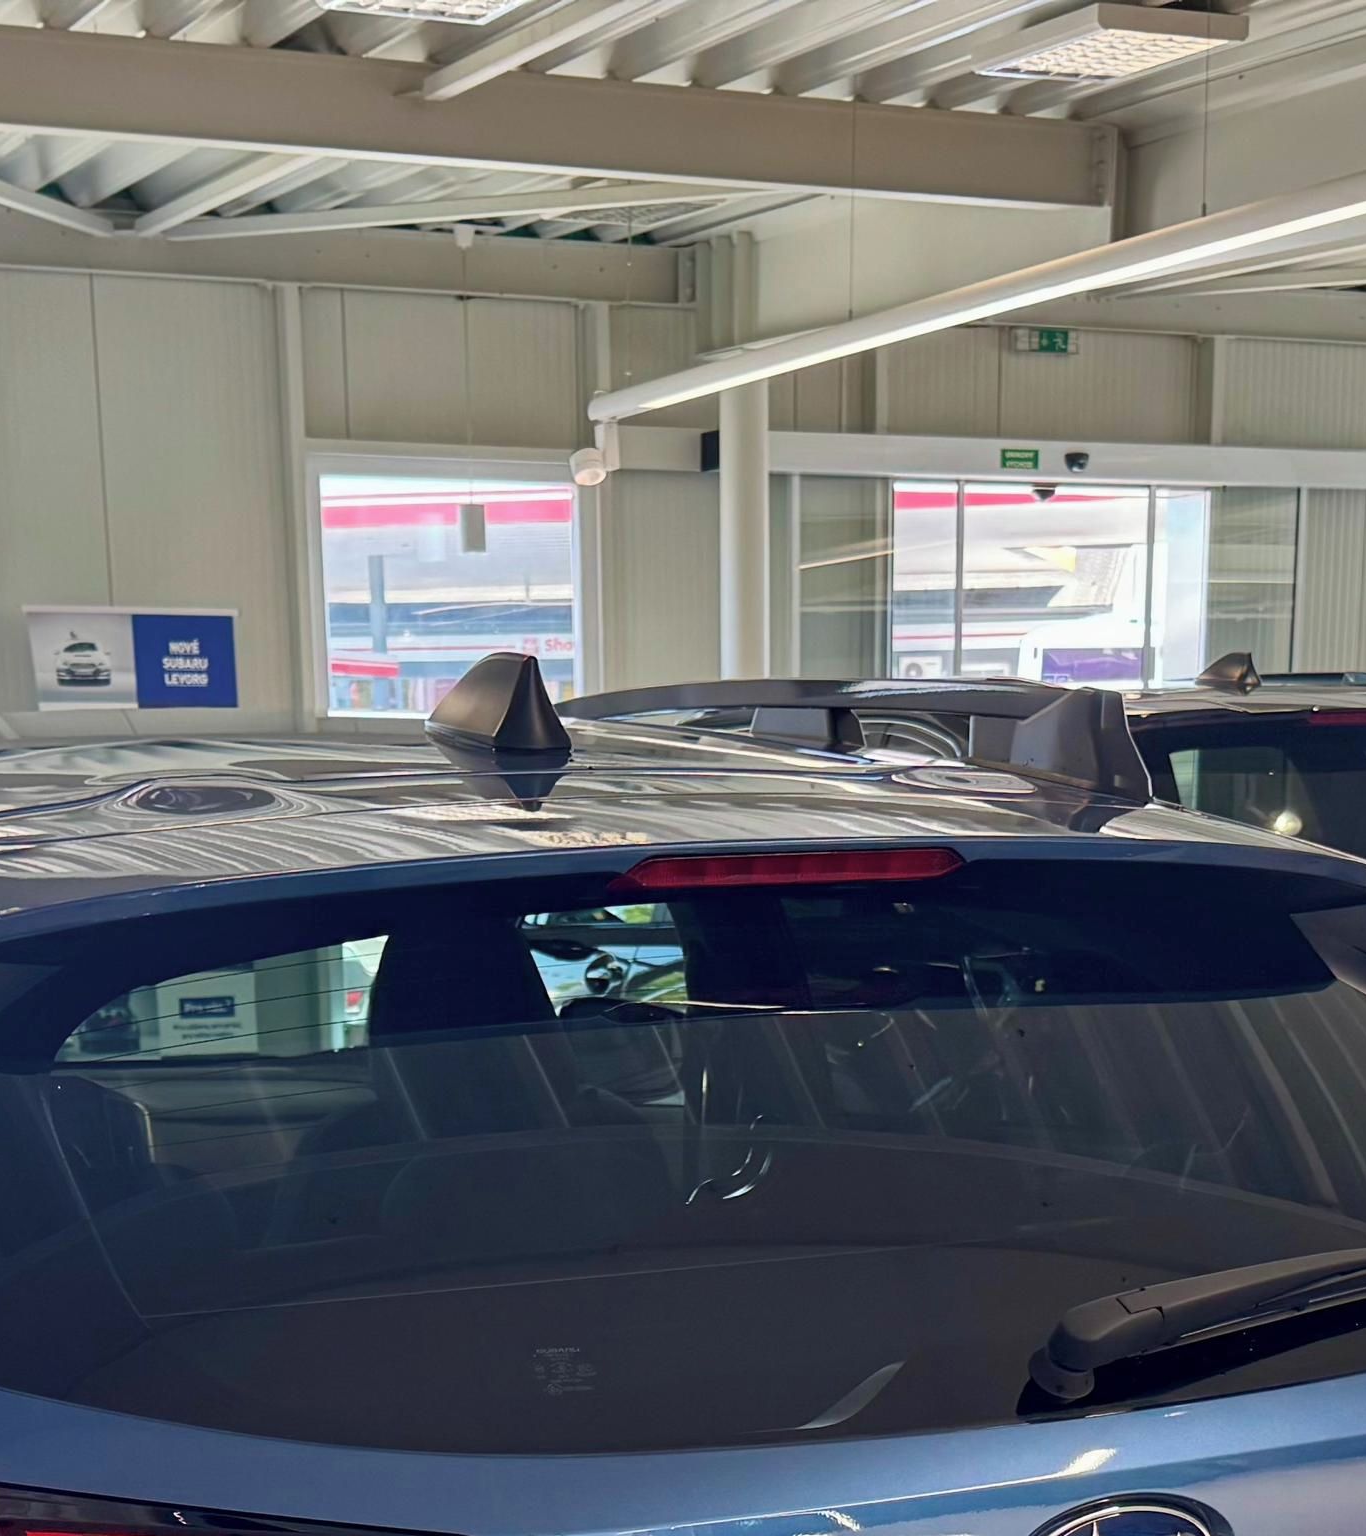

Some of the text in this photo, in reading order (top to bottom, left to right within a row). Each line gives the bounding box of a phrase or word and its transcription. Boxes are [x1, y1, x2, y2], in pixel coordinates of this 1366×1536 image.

[168, 638, 200, 656] NOVÉ
[162, 657, 209, 671] SUBARU
[164, 672, 209, 688] LEVORG
